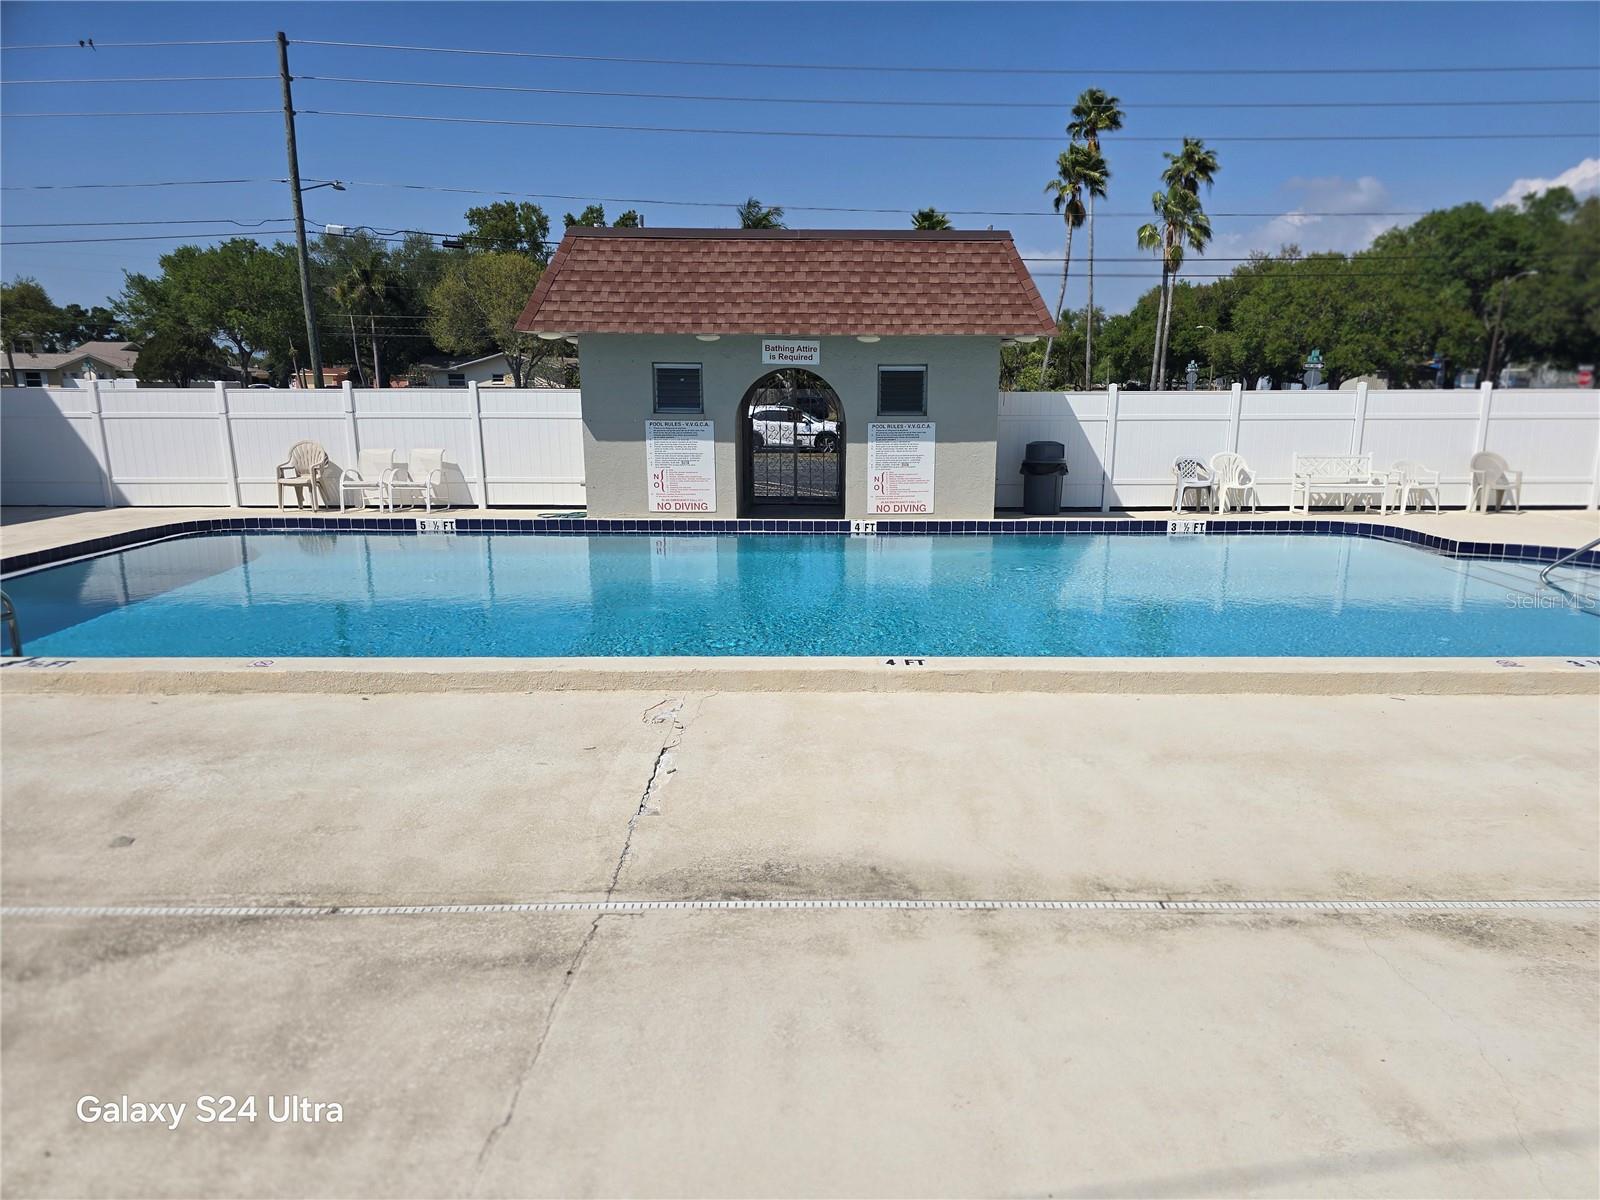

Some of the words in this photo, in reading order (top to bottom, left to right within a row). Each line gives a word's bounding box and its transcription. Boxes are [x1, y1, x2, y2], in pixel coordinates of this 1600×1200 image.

[764, 344, 795, 353] Bathing
[796, 345, 818, 353] Attire
[778, 353, 813, 362] Required
[657, 502, 671, 510] NO
[674, 502, 708, 510] DIVING
[876, 504, 891, 513] NO
[893, 504, 927, 513] DIVING
[420, 521, 426, 530] 5
[854, 523, 860, 531] 4
[864, 523, 875, 531] FT
[1171, 523, 1177, 531] 3
